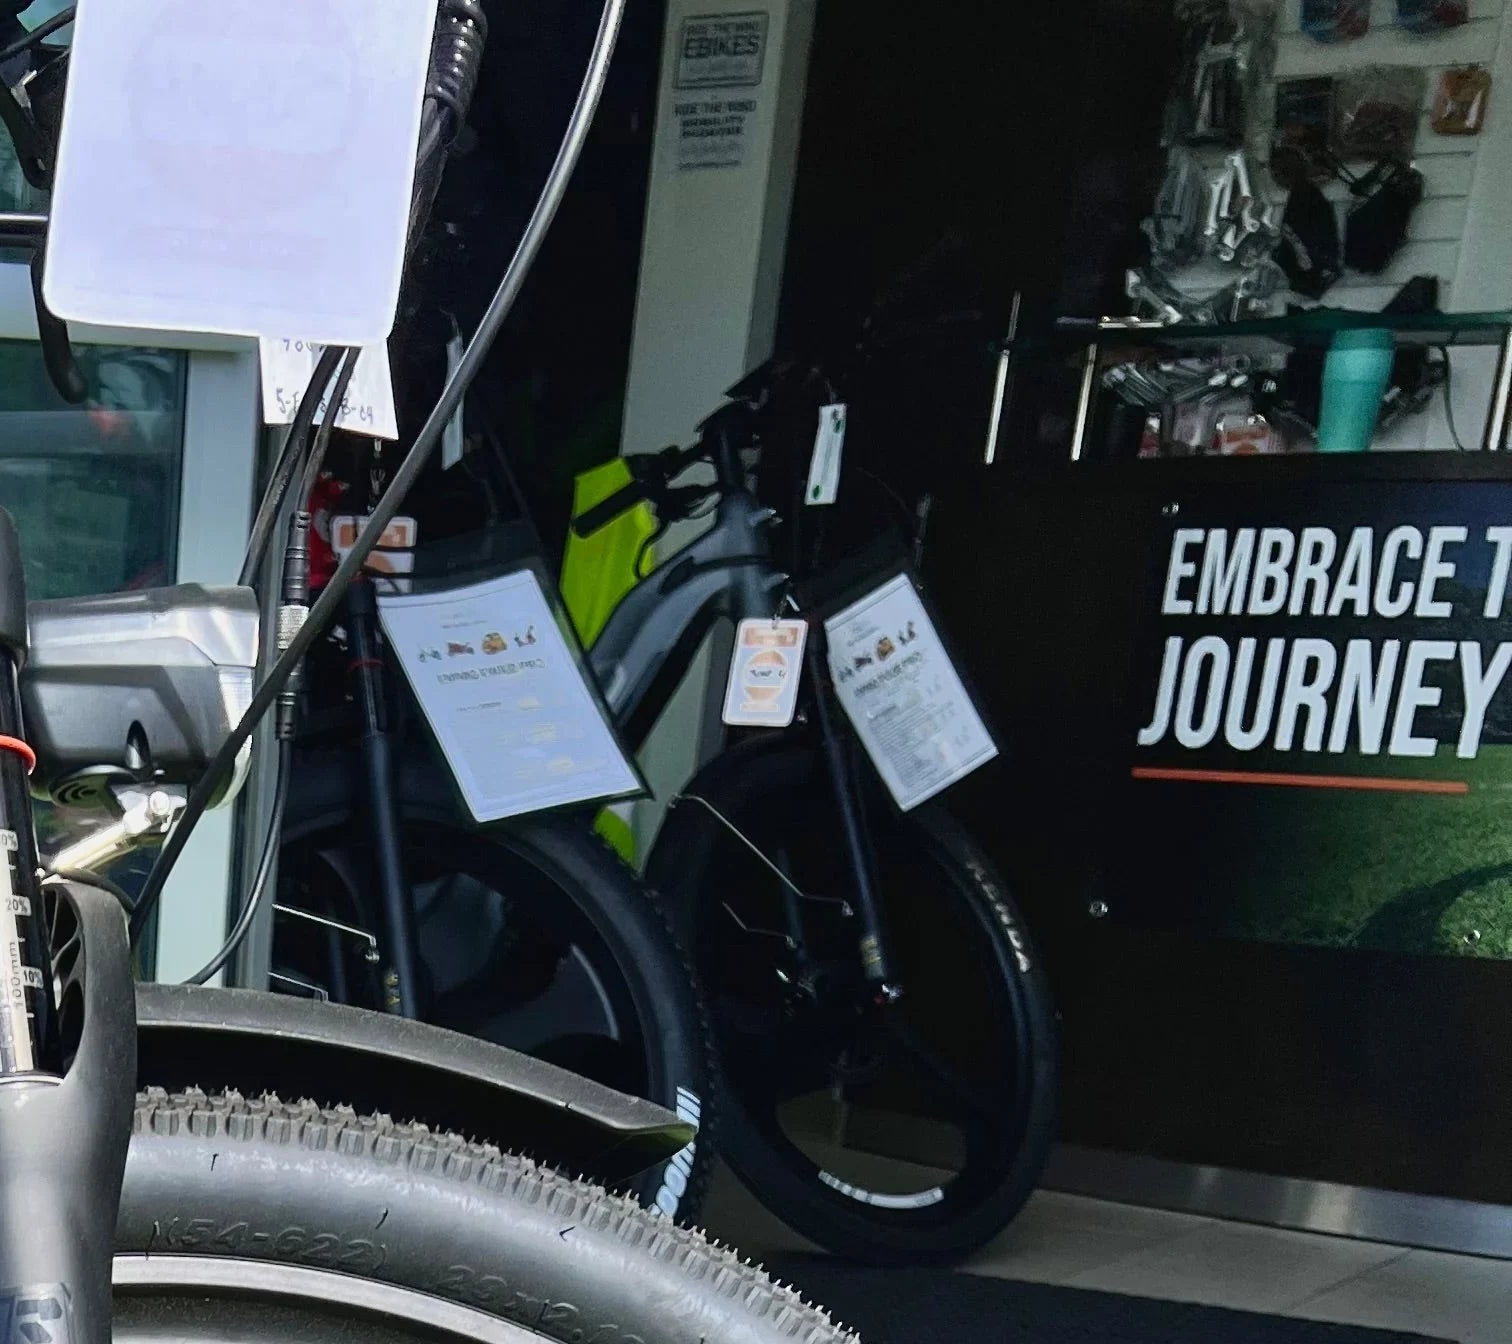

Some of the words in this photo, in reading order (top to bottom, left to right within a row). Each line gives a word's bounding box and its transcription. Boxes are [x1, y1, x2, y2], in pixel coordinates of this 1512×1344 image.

[684, 33, 760, 59] EBIKES
[1161, 525, 1468, 618] EMBRACE
[1137, 635, 1512, 759] JOURNEY
[6, 896, 29, 912] 20%
